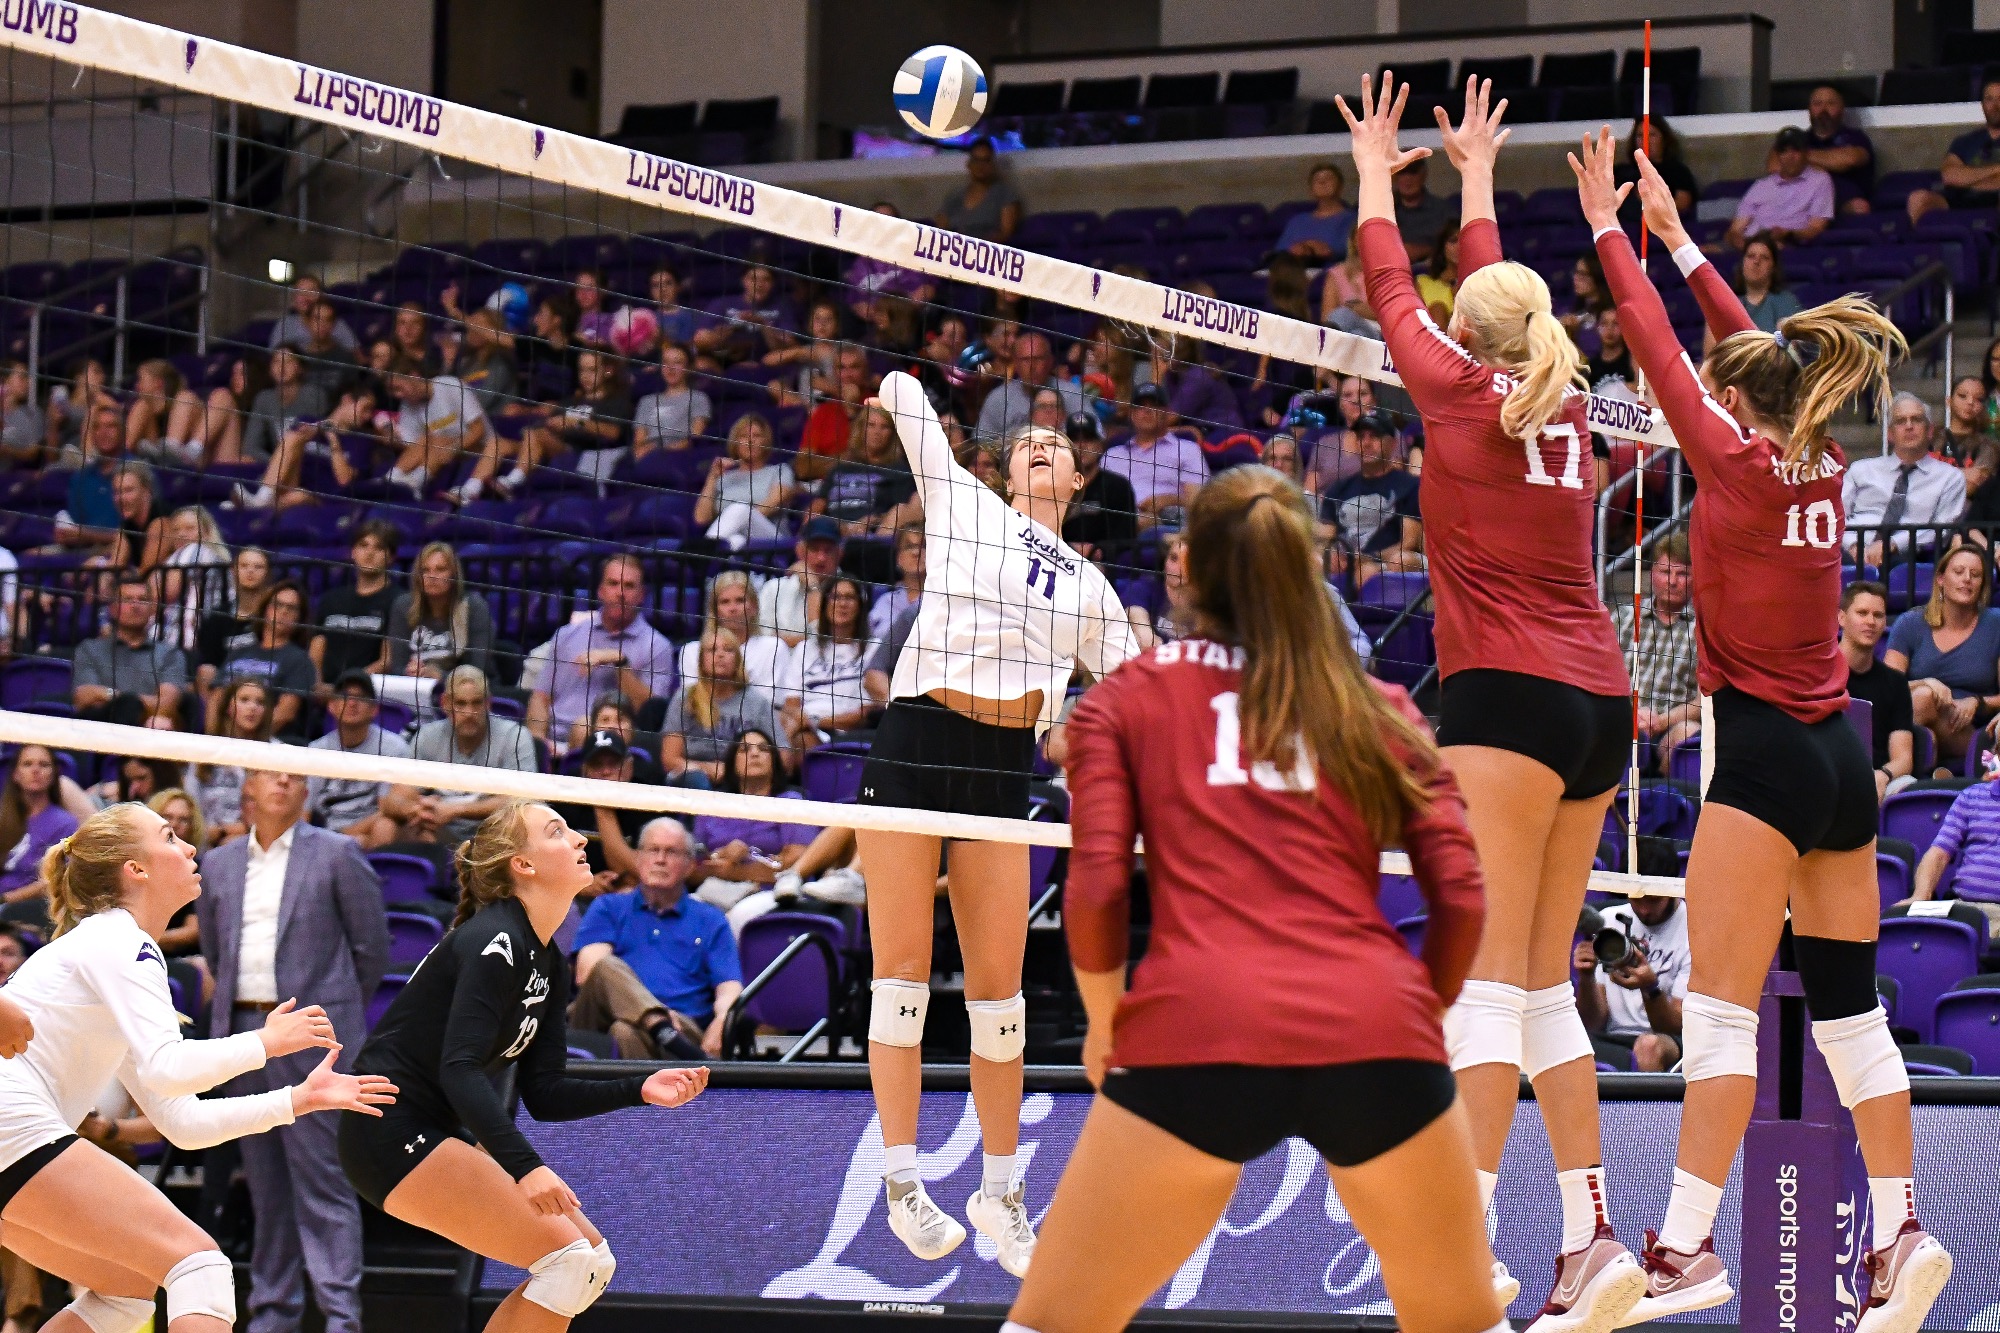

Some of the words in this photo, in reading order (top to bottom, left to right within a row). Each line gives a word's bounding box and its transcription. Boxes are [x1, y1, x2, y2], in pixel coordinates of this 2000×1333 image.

[0, 0, 78, 44] OMB
[294, 66, 443, 136] LIPSCOMB
[626, 149, 755, 215] LIPSCOMB
[914, 224, 1025, 282] LIPSCOMB
[1161, 287, 1260, 339] LIPSCOMB
[1587, 395, 1653, 434] PSCOMB
[1518, 421, 1584, 490] 17
[1781, 499, 1838, 549] 10
[1026, 556, 1057, 601] 11
[594, 731, 613, 747] L
[500, 1016, 538, 1058] 13
[1775, 1164, 1800, 1247] sports
[863, 1302, 945, 1315] DAKTRONICS
